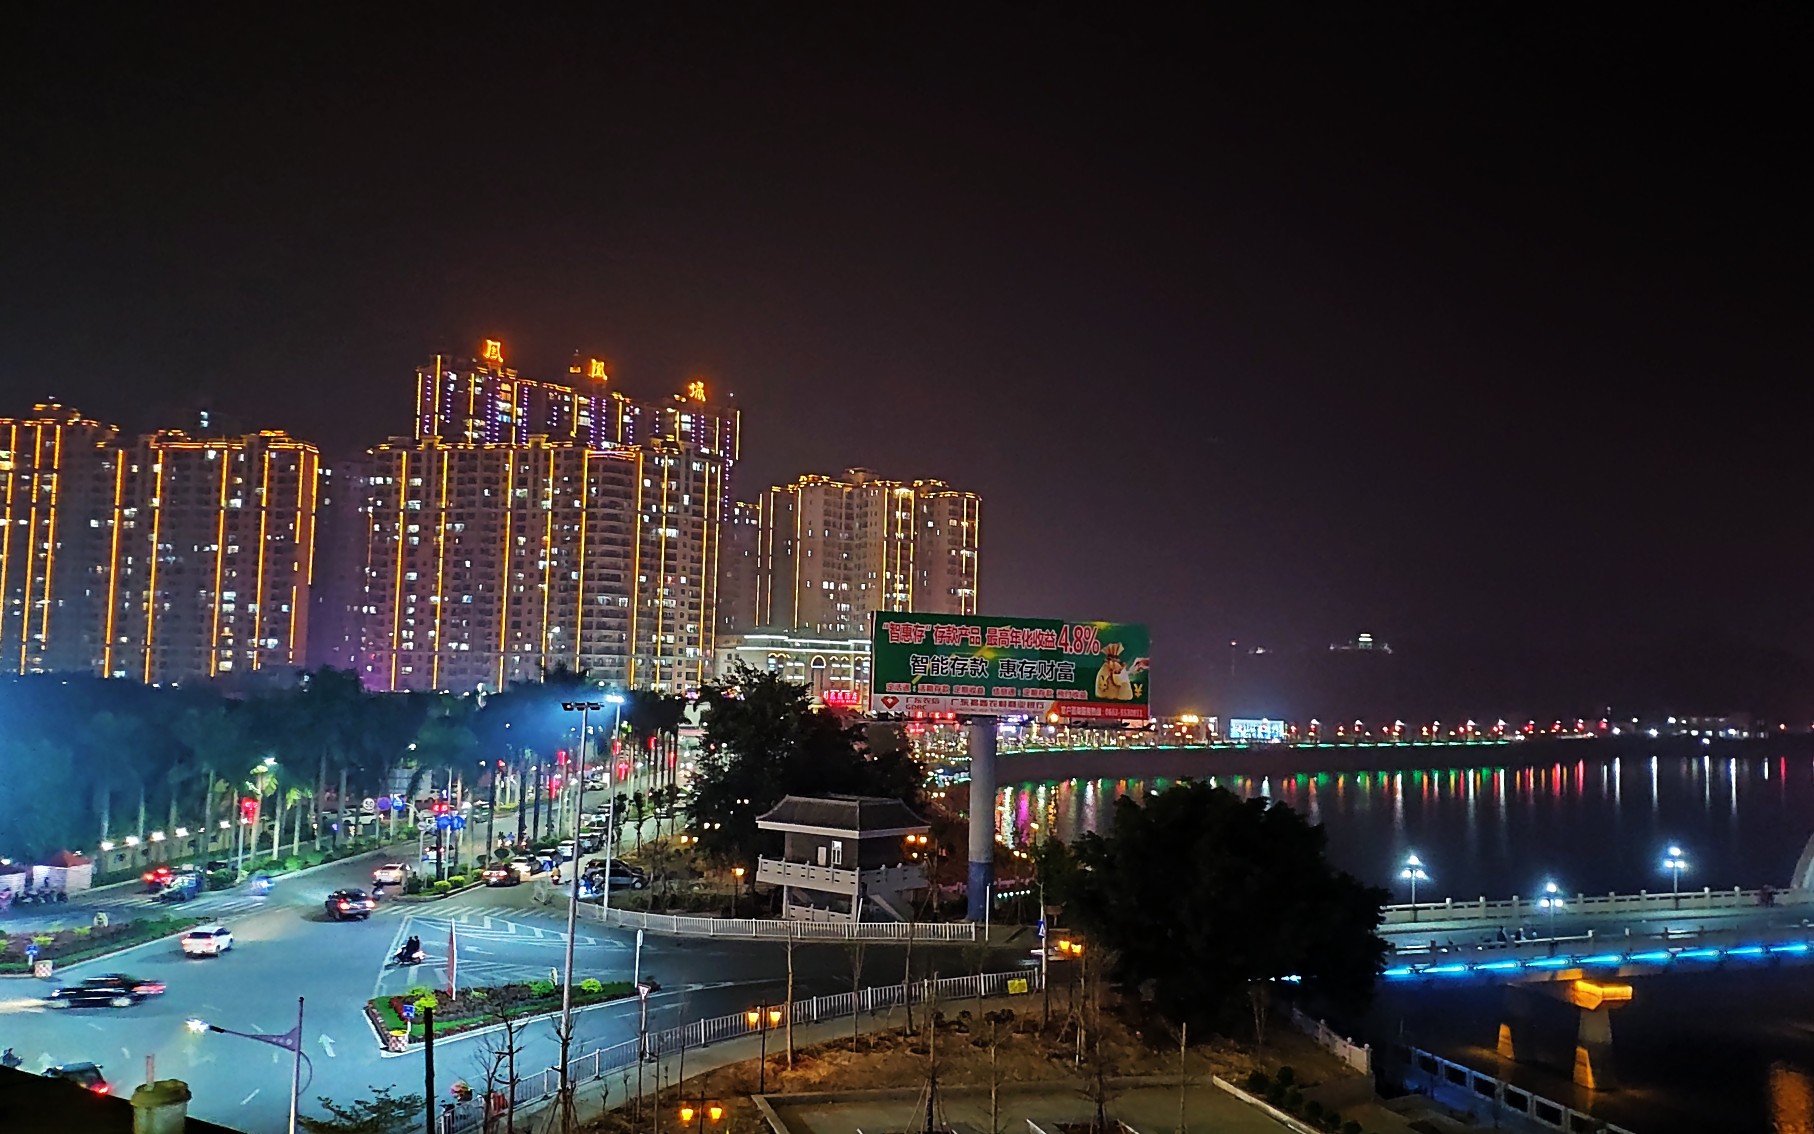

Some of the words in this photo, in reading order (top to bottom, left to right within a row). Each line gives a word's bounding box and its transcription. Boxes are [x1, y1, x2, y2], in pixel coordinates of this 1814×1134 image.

[933, 624, 981, 647] 存款产品
[986, 626, 1057, 650] 最高年化收益
[1057, 623, 1101, 656] 4.8%
[909, 653, 989, 679] 智能存款
[998, 658, 1076, 683] 惠存财富
